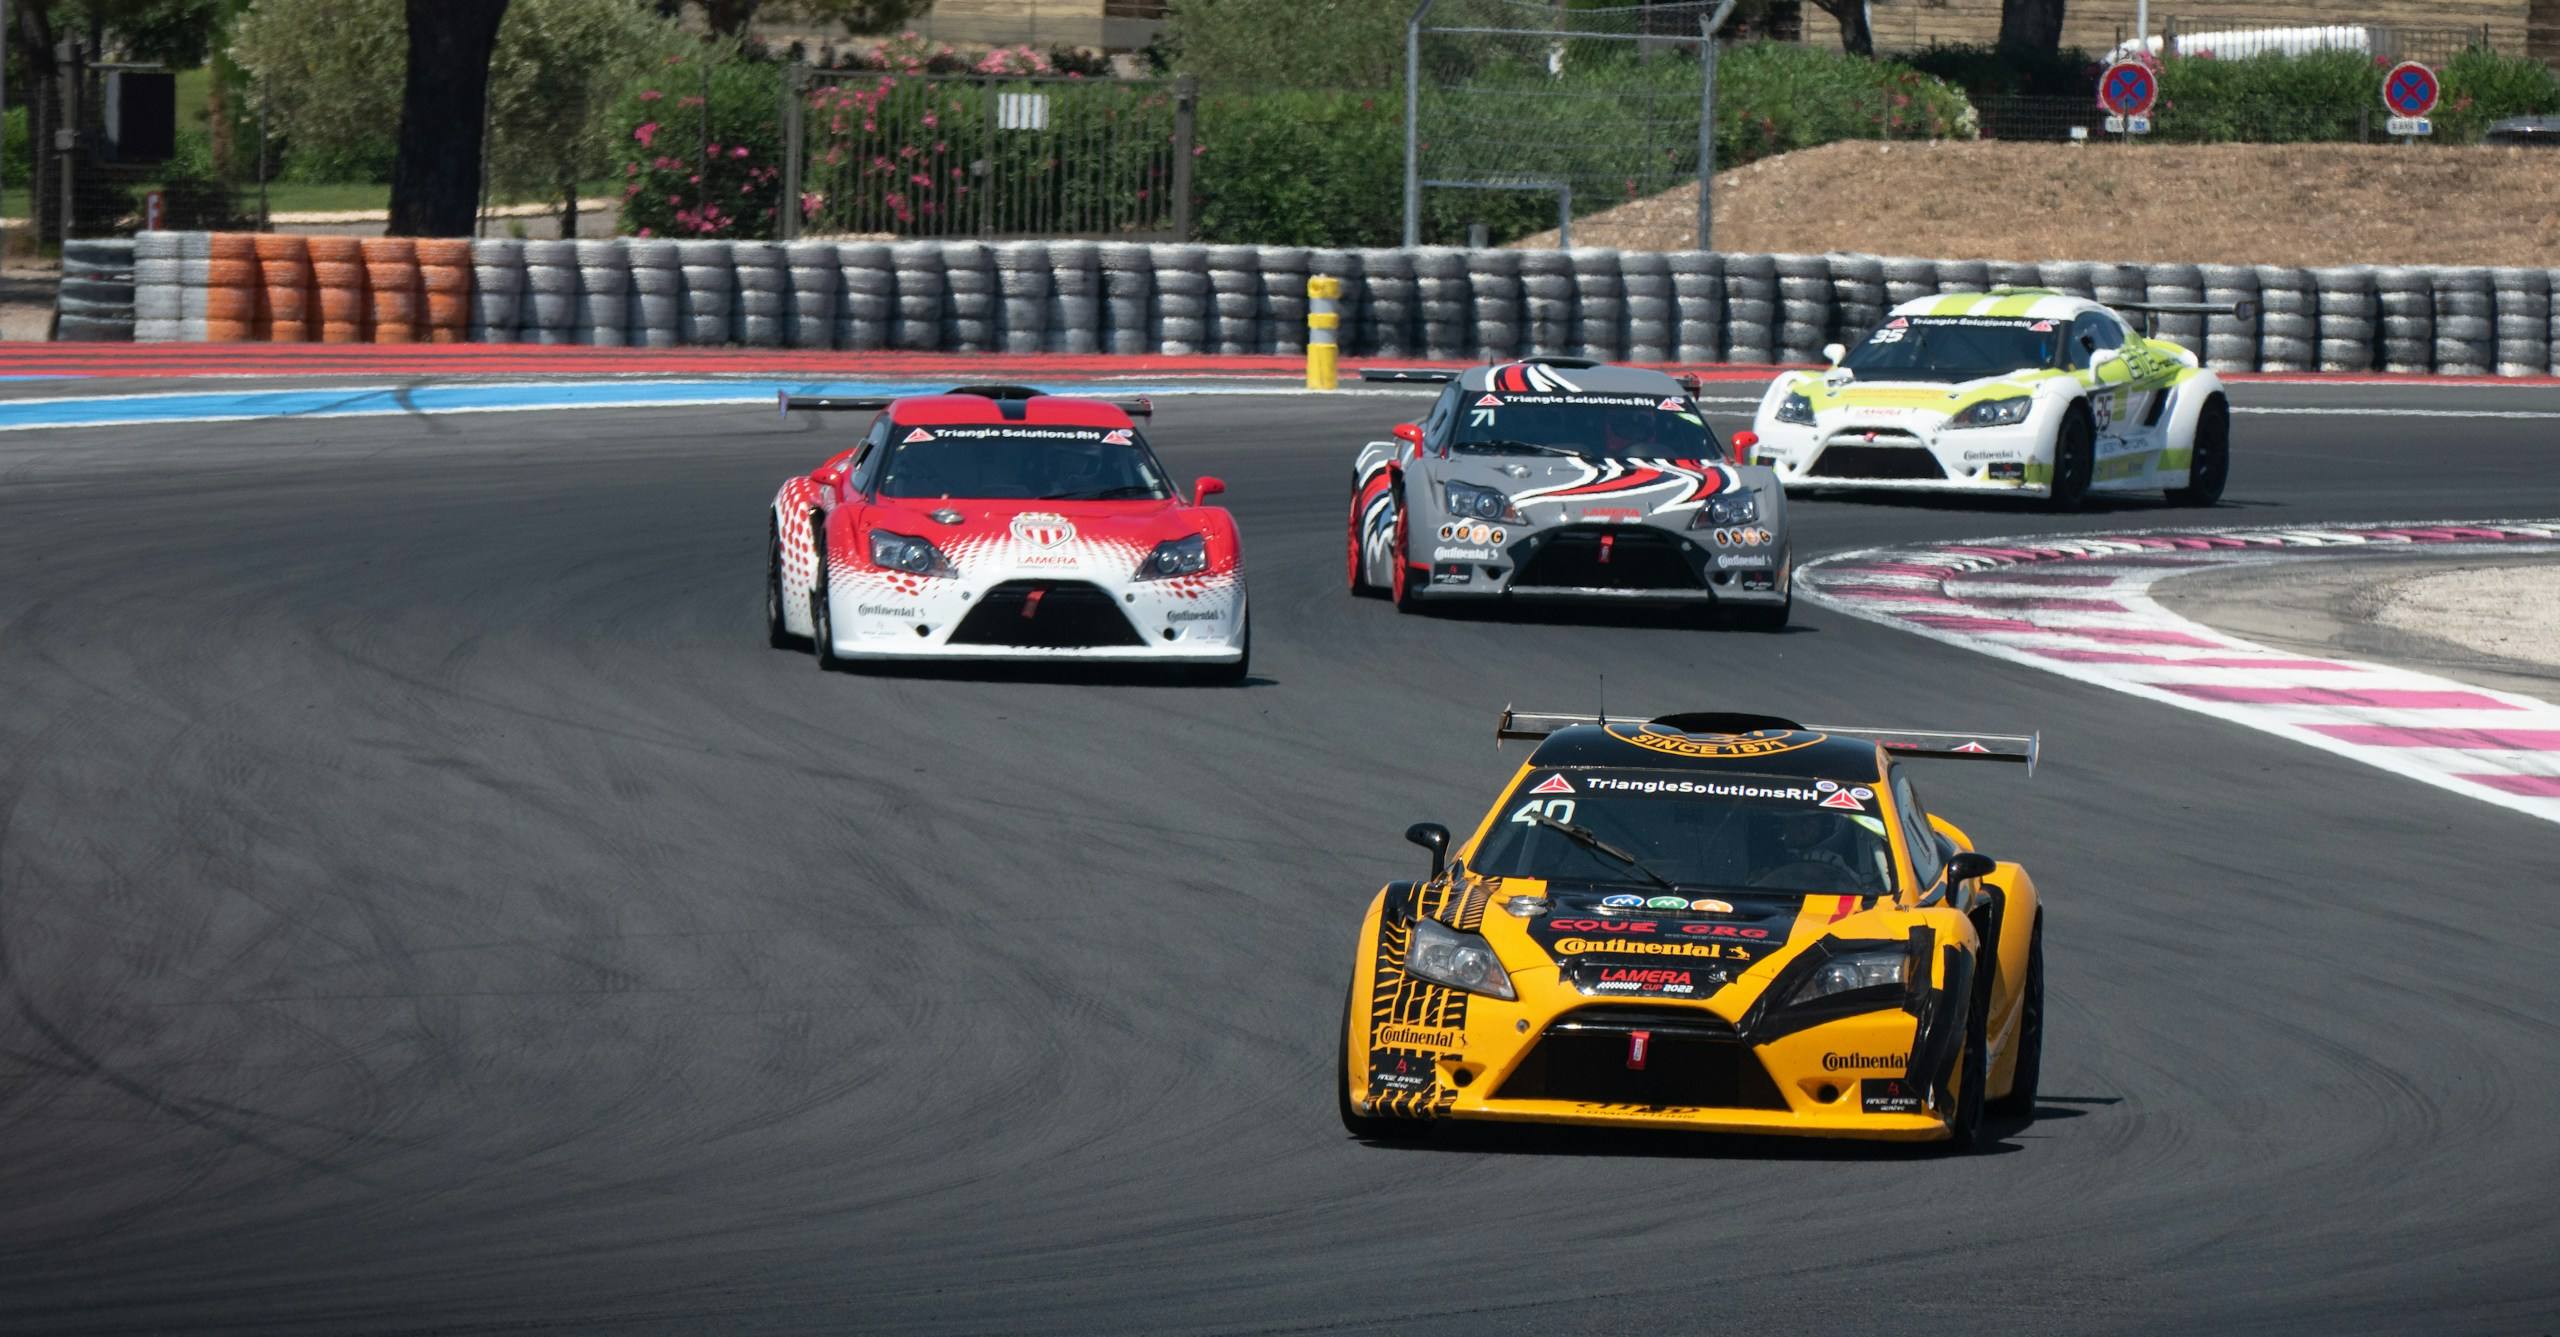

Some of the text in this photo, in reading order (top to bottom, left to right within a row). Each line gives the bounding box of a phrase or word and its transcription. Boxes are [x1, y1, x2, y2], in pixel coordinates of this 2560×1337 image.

[1869, 329, 1908, 344] 35
[1470, 409, 1495, 427] 71
[858, 603, 915, 617] Continental
[1631, 734, 1789, 755] SINCE 1871
[1511, 799, 1576, 826] 40
[1681, 924, 1770, 938] GRG
[1554, 937, 1721, 958] Continental
[1600, 968, 1692, 985] LAMERA
[1642, 983, 1694, 993] CUP 2022
[1380, 1025, 1454, 1048] Continental
[1822, 1052, 1908, 1072] Continental
